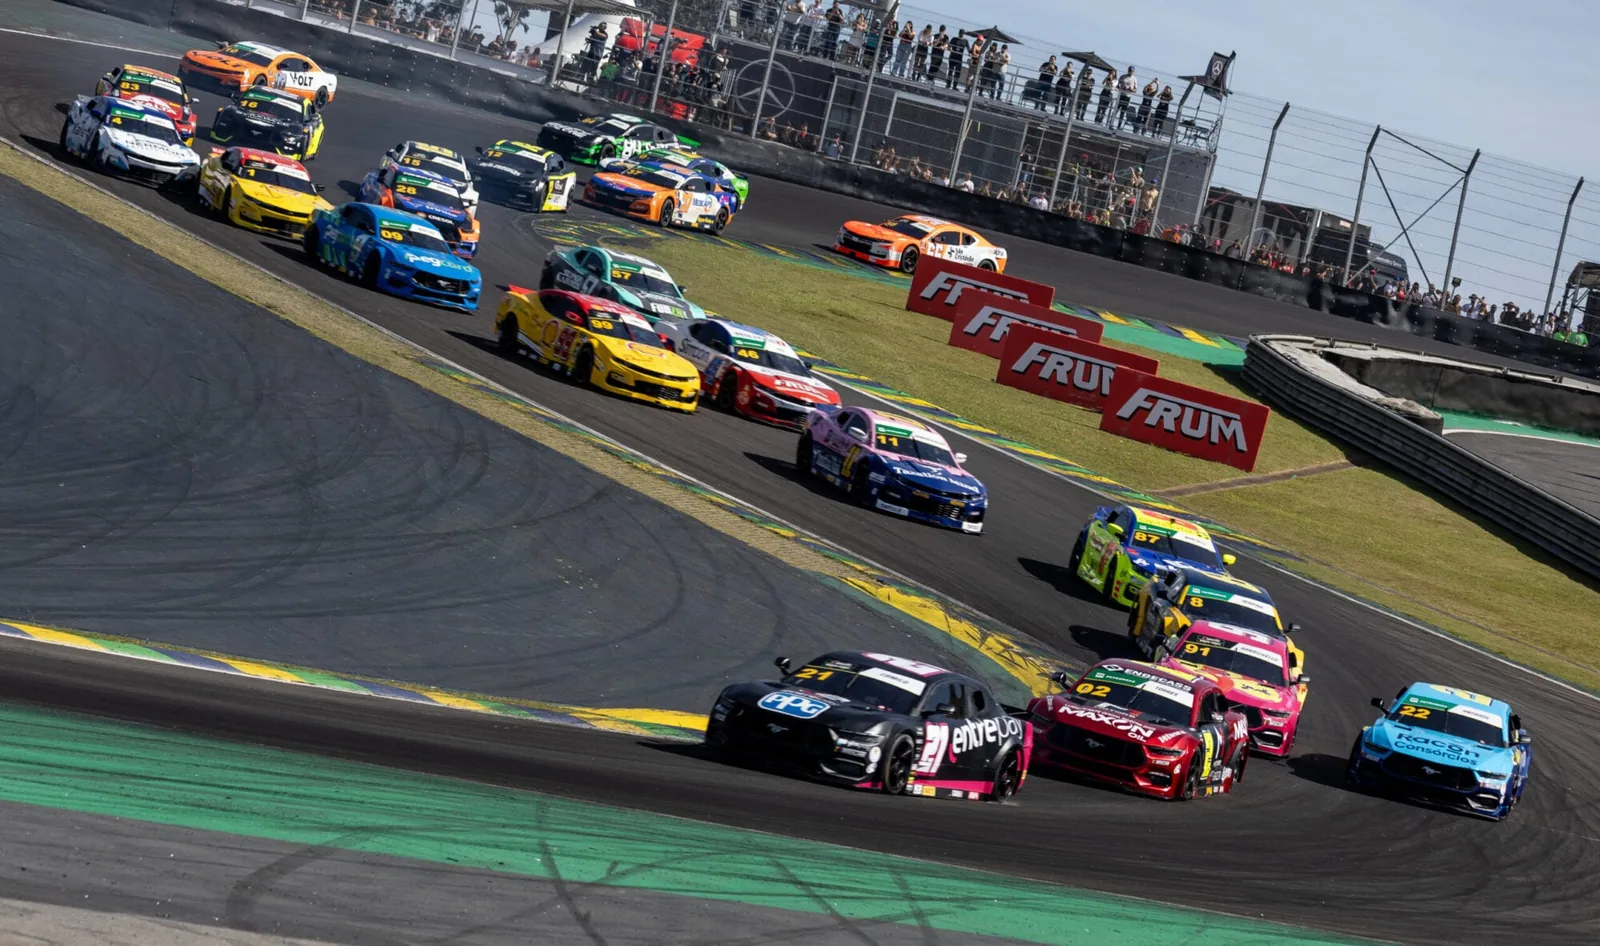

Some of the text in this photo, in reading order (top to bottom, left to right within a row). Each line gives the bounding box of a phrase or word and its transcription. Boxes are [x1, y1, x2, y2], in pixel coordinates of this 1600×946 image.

[120, 81, 139, 91] 83
[290, 73, 313, 87] VOLT
[240, 100, 258, 108] 16
[111, 117, 122, 125] 4
[402, 157, 420, 167] 15
[396, 185, 416, 195] 28
[381, 229, 404, 241] 09
[612, 269, 631, 280] 57
[590, 319, 613, 330] 99
[738, 349, 760, 359] 46
[1117, 388, 1247, 451] FRUM
[877, 434, 898, 447] 11
[1134, 531, 1160, 544] 87
[1189, 597, 1203, 608] 8
[1184, 643, 1211, 657] 91
[795, 668, 833, 681] 21
[1076, 682, 1112, 698] 02
[765, 694, 824, 714] PPG
[1399, 705, 1431, 720] 22
[1058, 706, 1154, 738] MAXON
[951, 716, 1023, 754] entrepay
[1128, 731, 1148, 743] OIL
[1396, 732, 1480, 758] Racon
[1394, 740, 1478, 766] Consórcios
